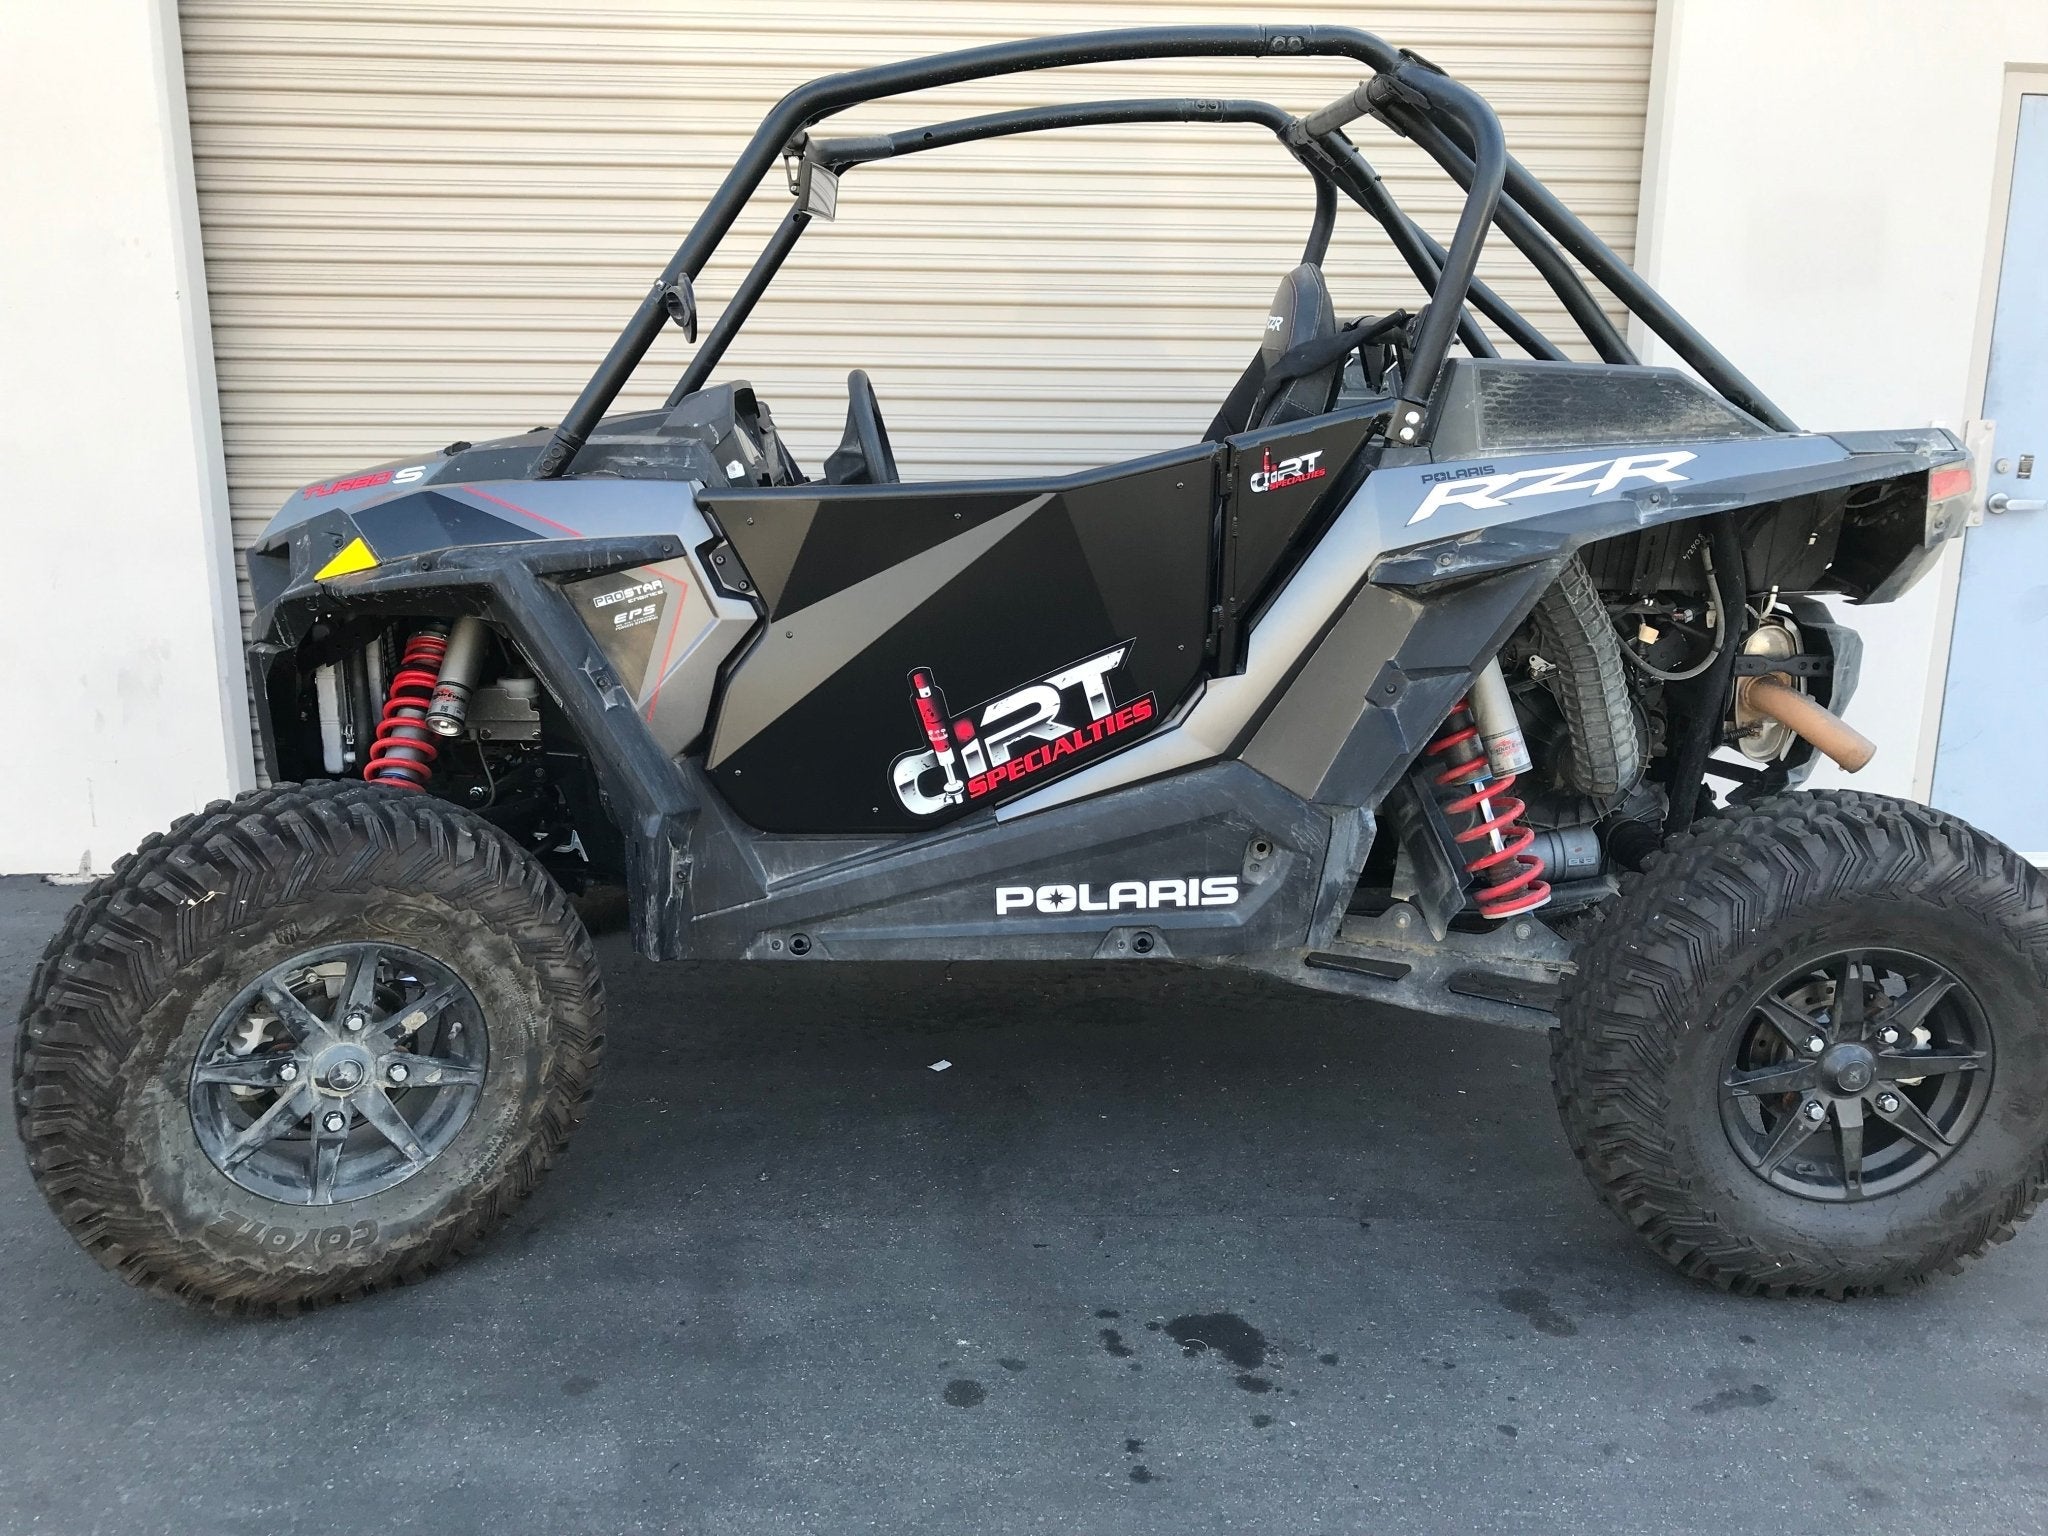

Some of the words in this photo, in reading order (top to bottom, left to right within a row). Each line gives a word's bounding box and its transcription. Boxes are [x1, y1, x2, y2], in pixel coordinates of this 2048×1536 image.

[303, 470, 395, 501] TURBO
[392, 465, 427, 485] S
[1269, 468, 1327, 491] SPECIALTIES
[1405, 450, 1699, 528] RZR
[1421, 465, 1496, 484] POLARIS
[593, 579, 664, 608] PROSTAR
[613, 603, 656, 625] EPS
[968, 698, 1152, 799] SPECIALTIES
[995, 876, 1239, 915] POLARIS
